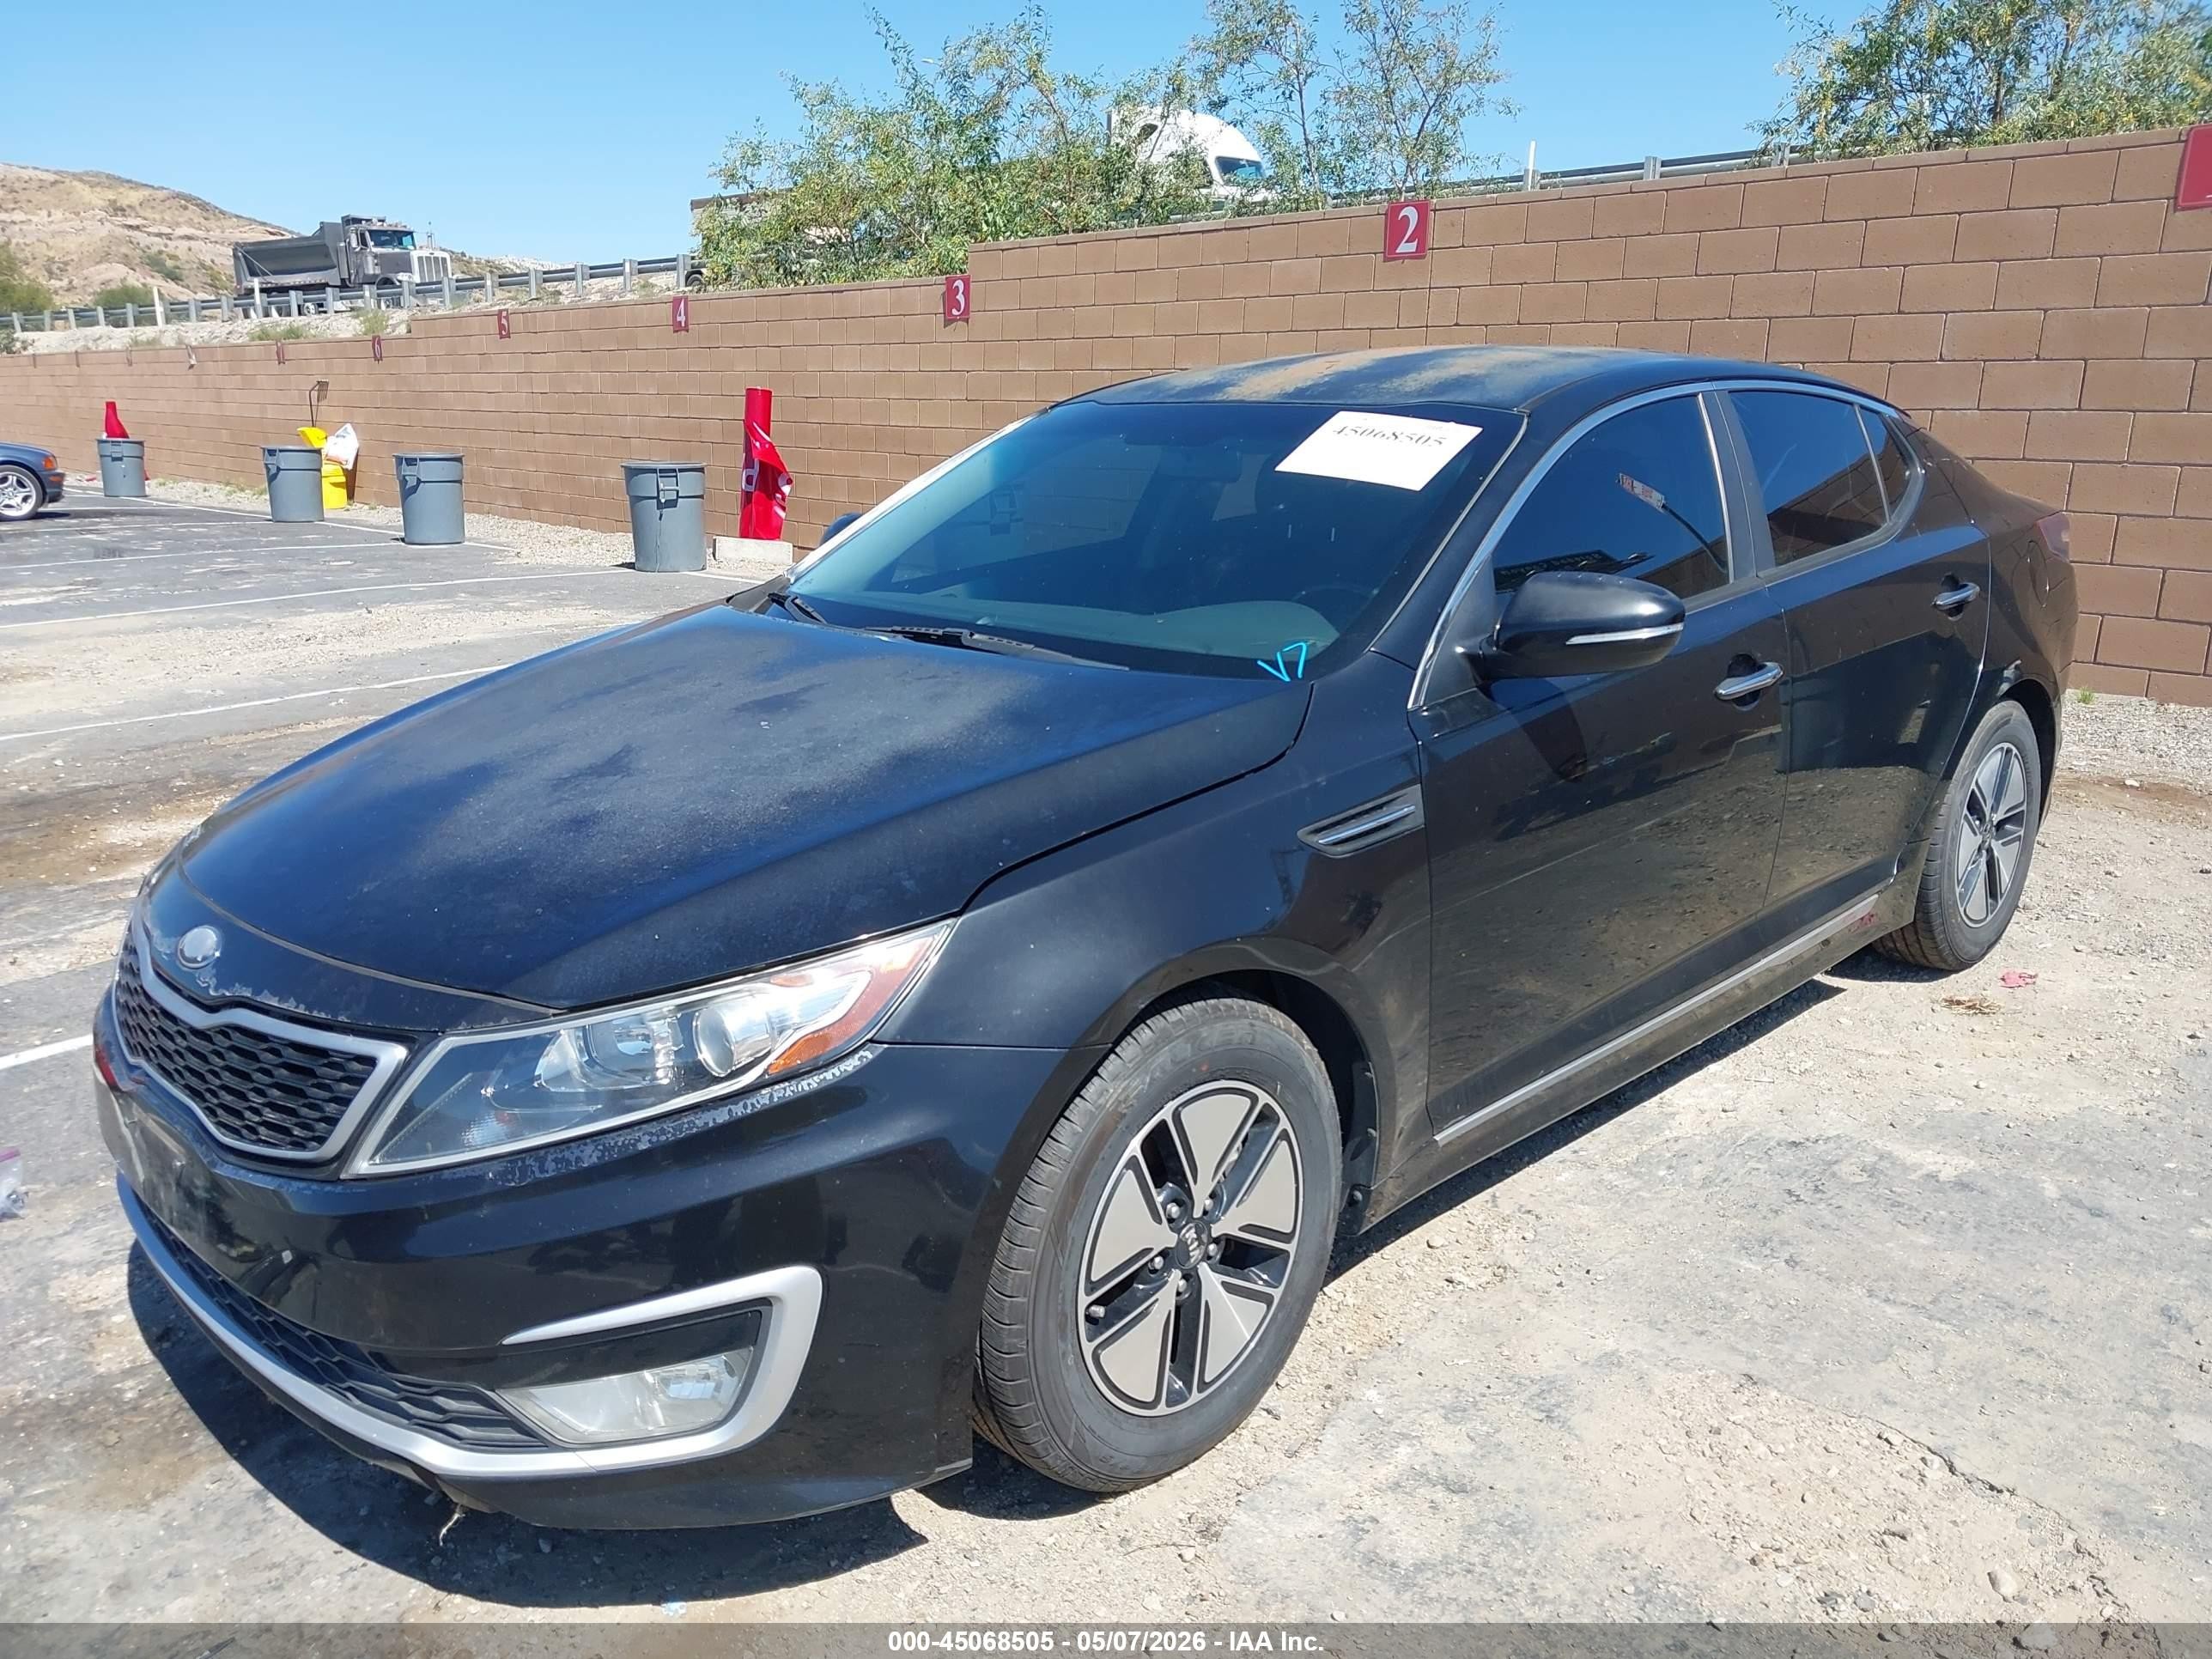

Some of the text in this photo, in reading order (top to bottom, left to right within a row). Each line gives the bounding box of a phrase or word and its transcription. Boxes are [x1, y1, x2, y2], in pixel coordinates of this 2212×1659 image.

[1395, 205, 1419, 254] 2
[951, 278, 966, 317] 3
[501, 310, 508, 336] 5
[676, 298, 686, 328] 4
[374, 337, 381, 359] 6
[1333, 425, 1448, 447] 45068505
